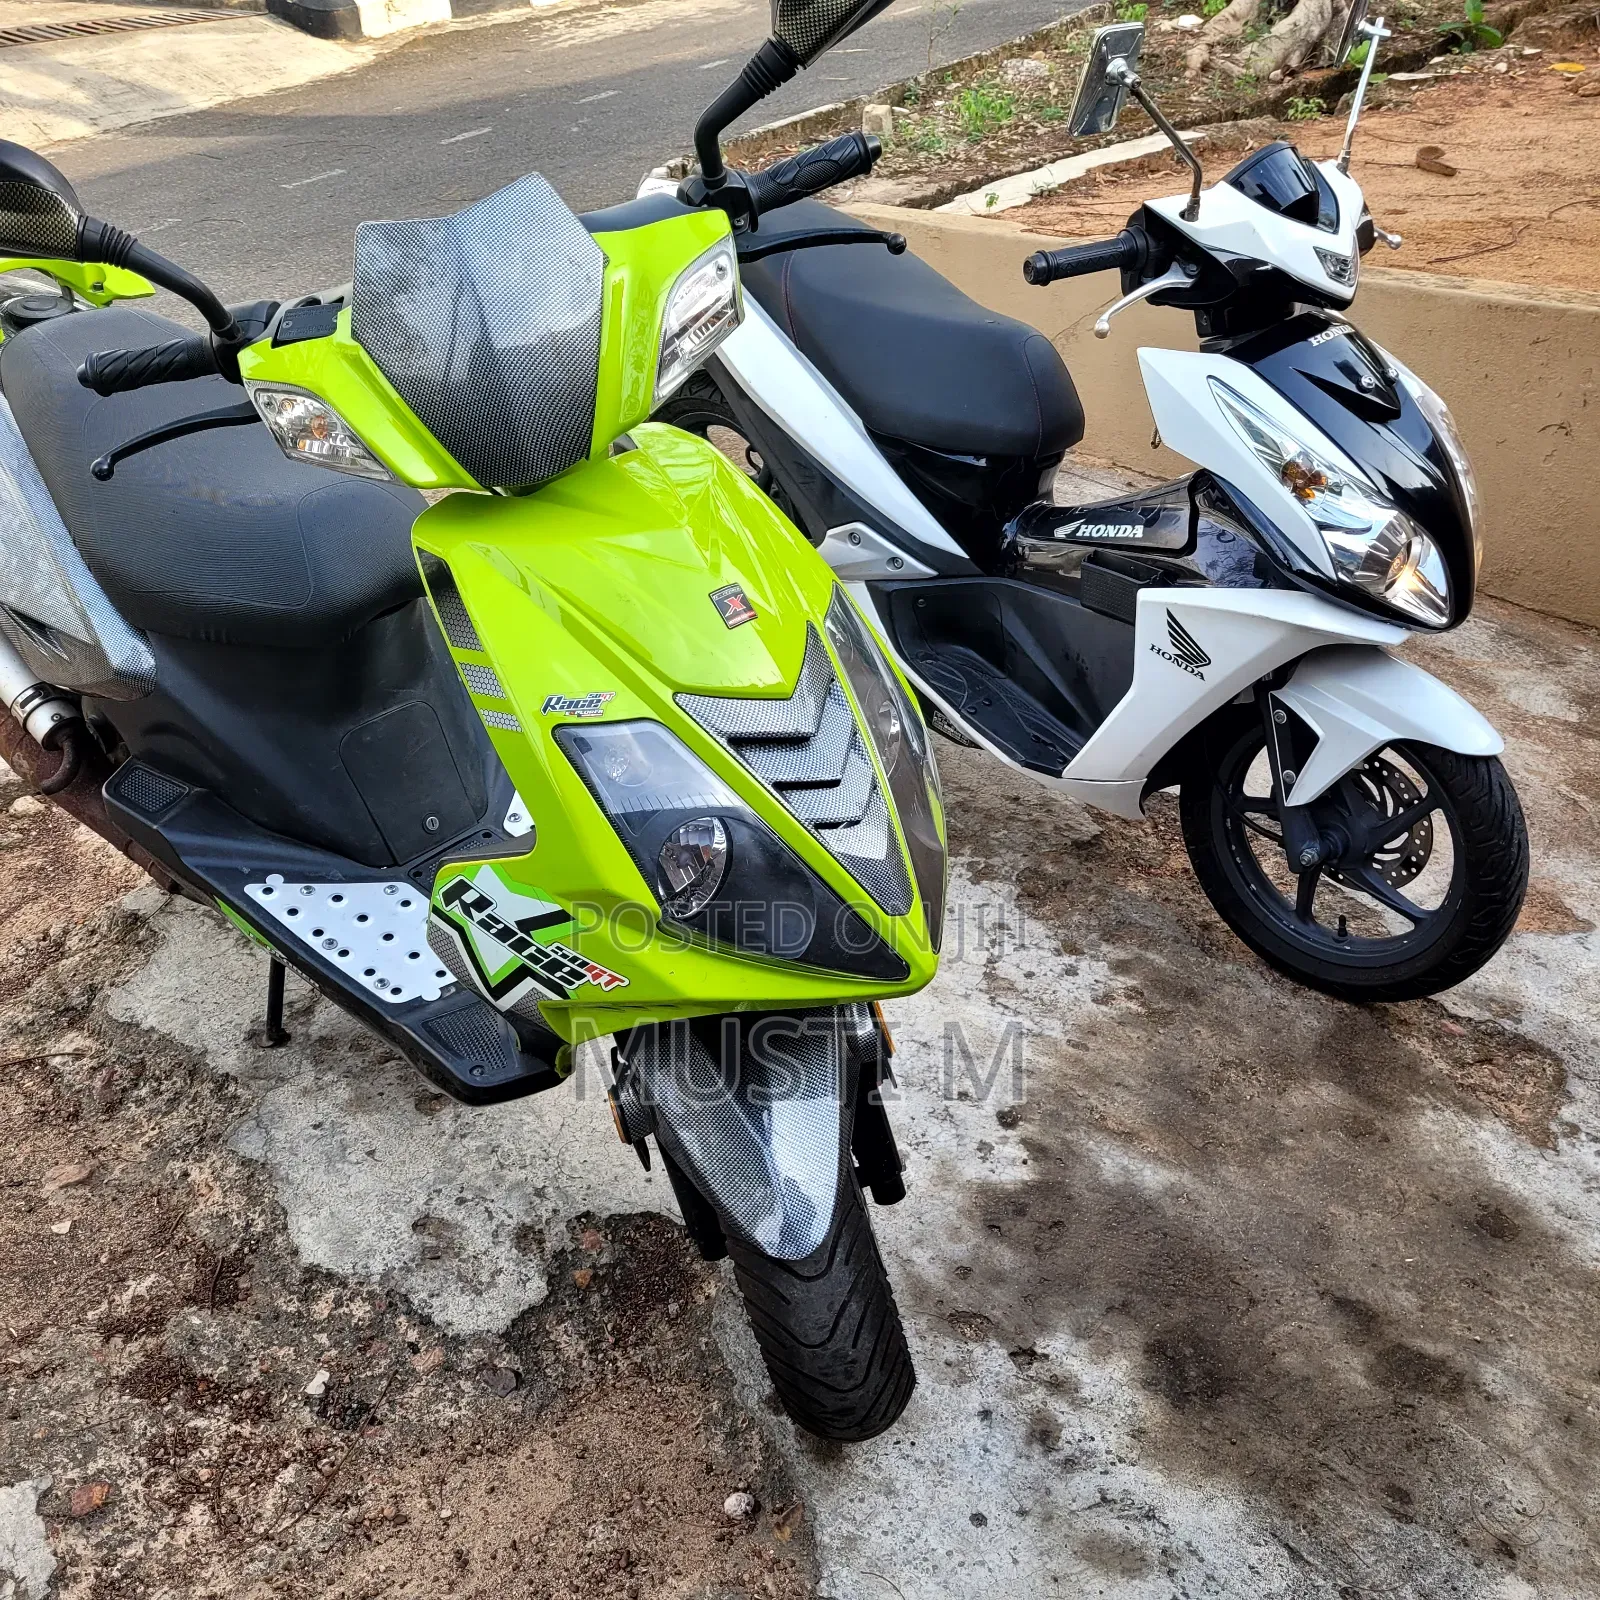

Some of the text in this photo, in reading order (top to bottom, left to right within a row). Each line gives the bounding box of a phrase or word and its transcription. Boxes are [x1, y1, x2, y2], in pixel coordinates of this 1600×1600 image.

[1076, 524, 1144, 538] HONDA
[1149, 643, 1206, 682] HONDA
[541, 695, 602, 715] Race
[439, 876, 590, 989] Race
